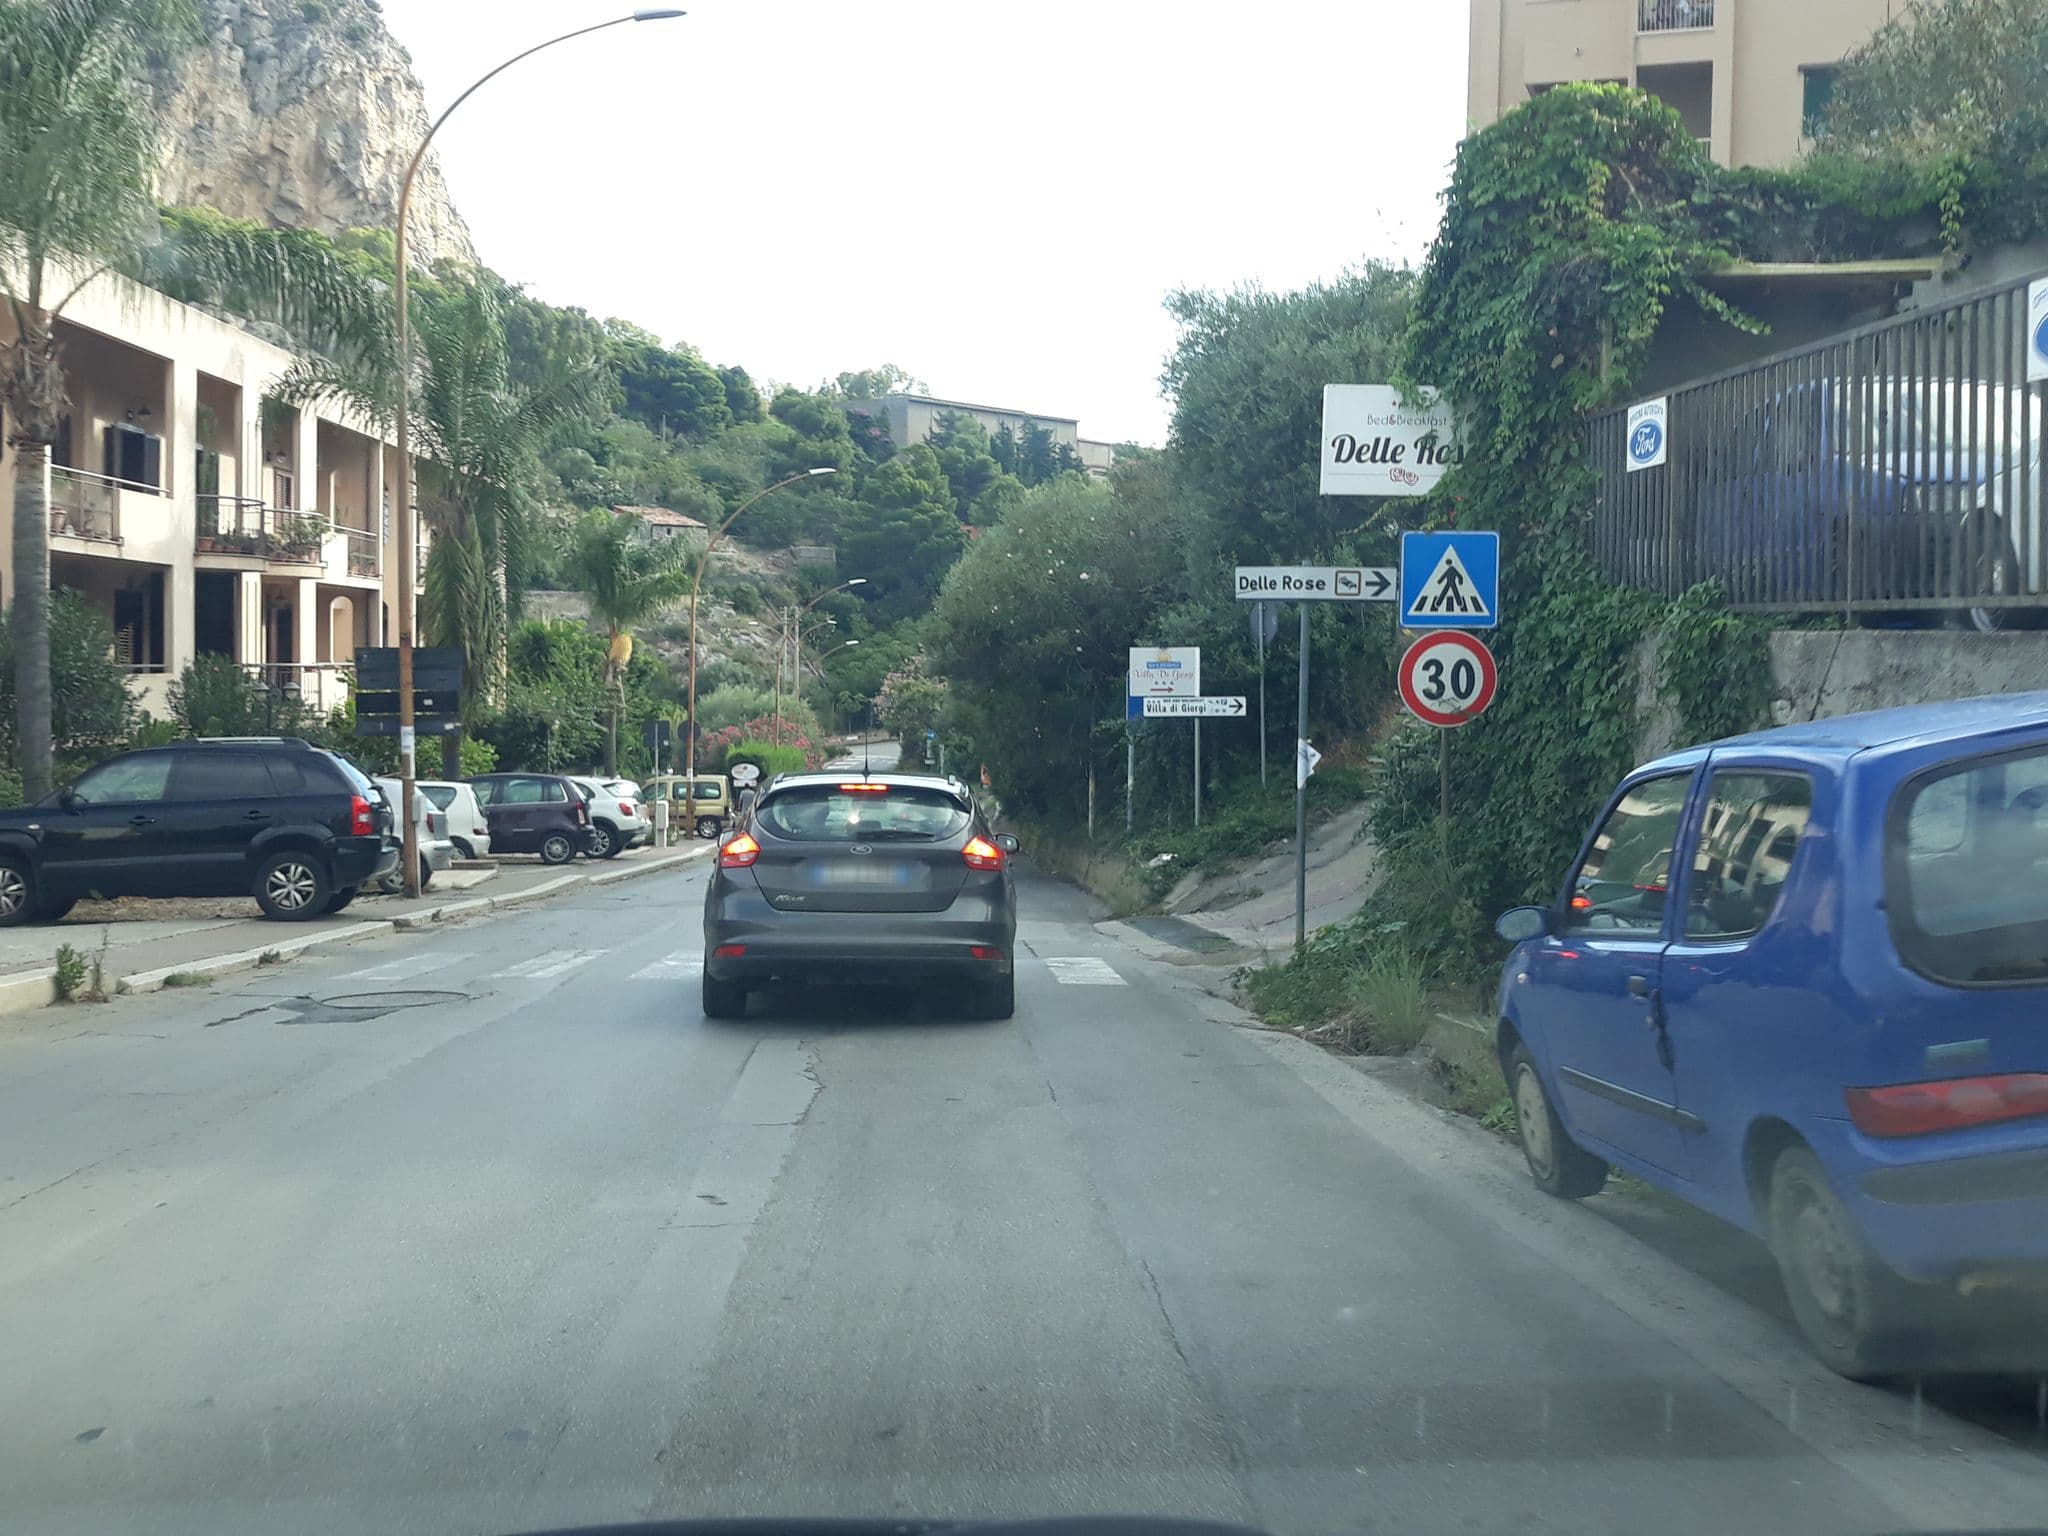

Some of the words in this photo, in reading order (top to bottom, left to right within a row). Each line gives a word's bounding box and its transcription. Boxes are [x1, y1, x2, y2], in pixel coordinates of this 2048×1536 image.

[1331, 433, 1406, 464] Delle
[1635, 425, 1656, 456] Ford
[1238, 575, 1277, 591] Delle
[1282, 575, 1326, 591] Rose
[1421, 657, 1476, 700] 30
[1146, 703, 1167, 713] Villa
[1170, 703, 1178, 713] di
[1181, 703, 1207, 714] Giorgi
